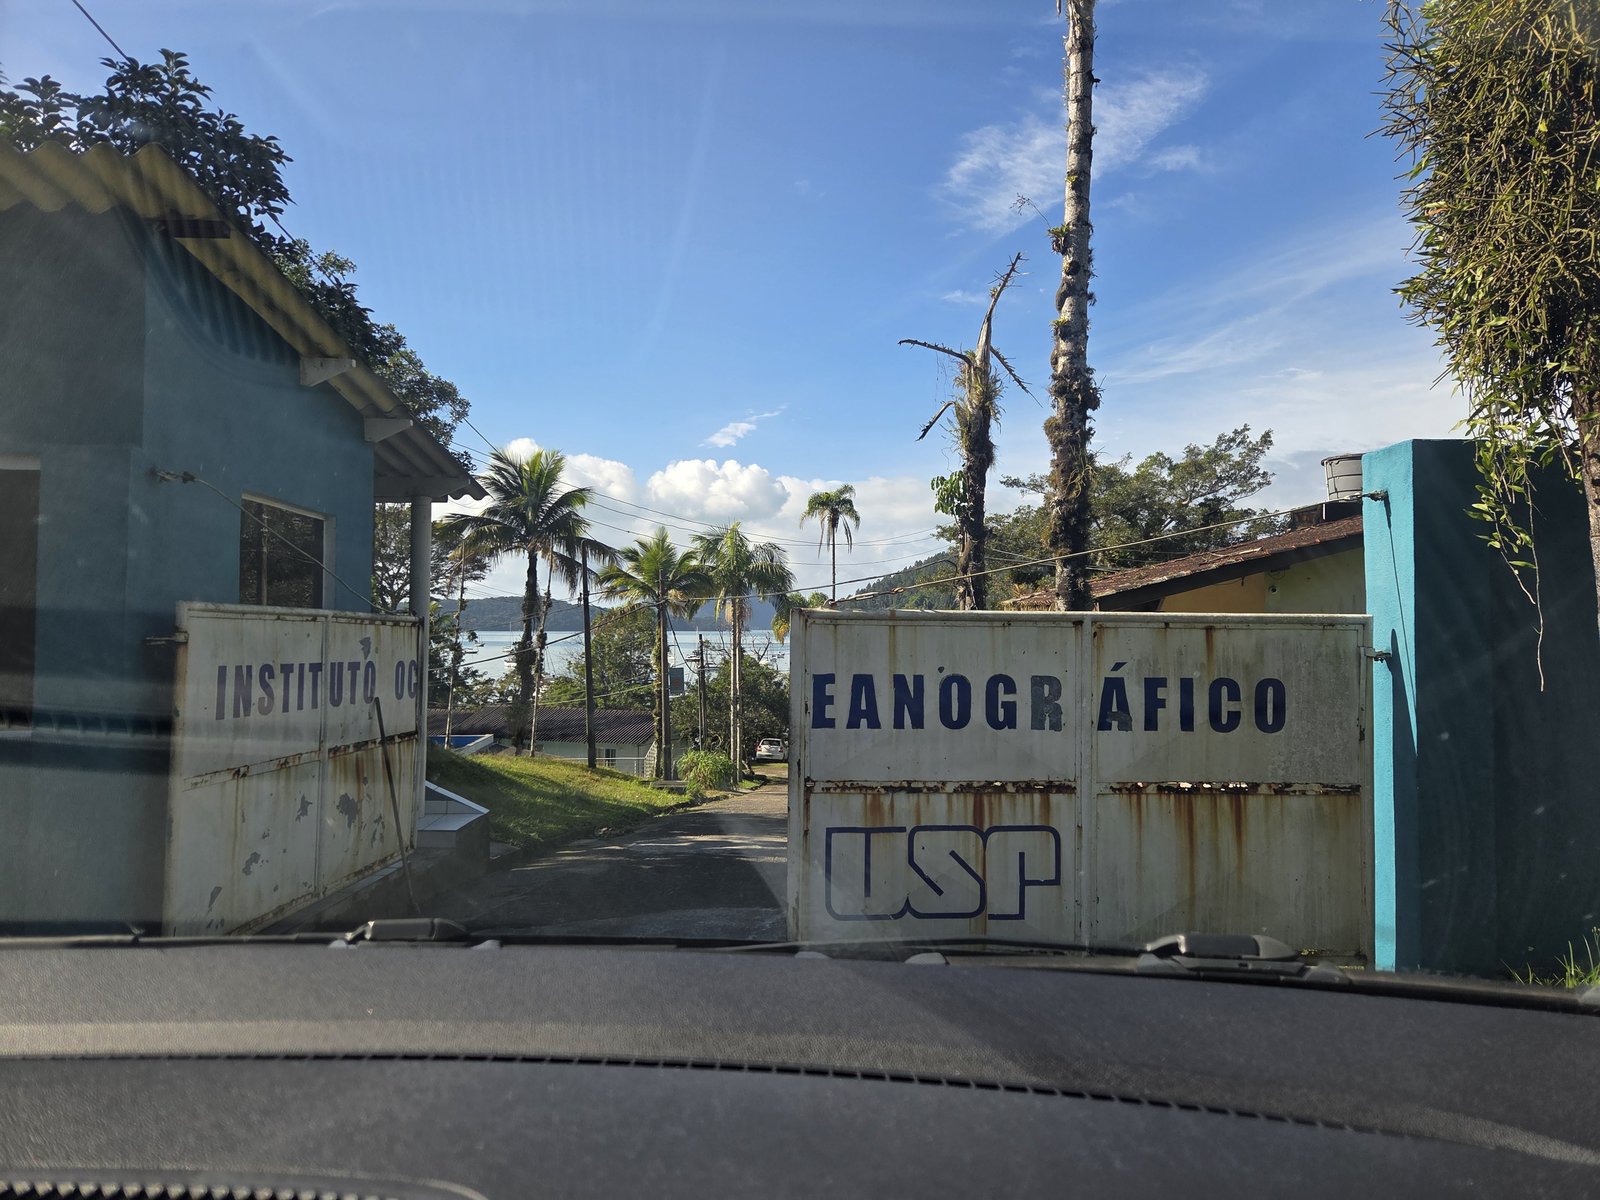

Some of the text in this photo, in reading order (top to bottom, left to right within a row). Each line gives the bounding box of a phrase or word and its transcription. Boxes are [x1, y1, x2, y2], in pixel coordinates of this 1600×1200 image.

[215, 659, 417, 721] INSTITUTO OC
[825, 825, 1061, 921] USP
